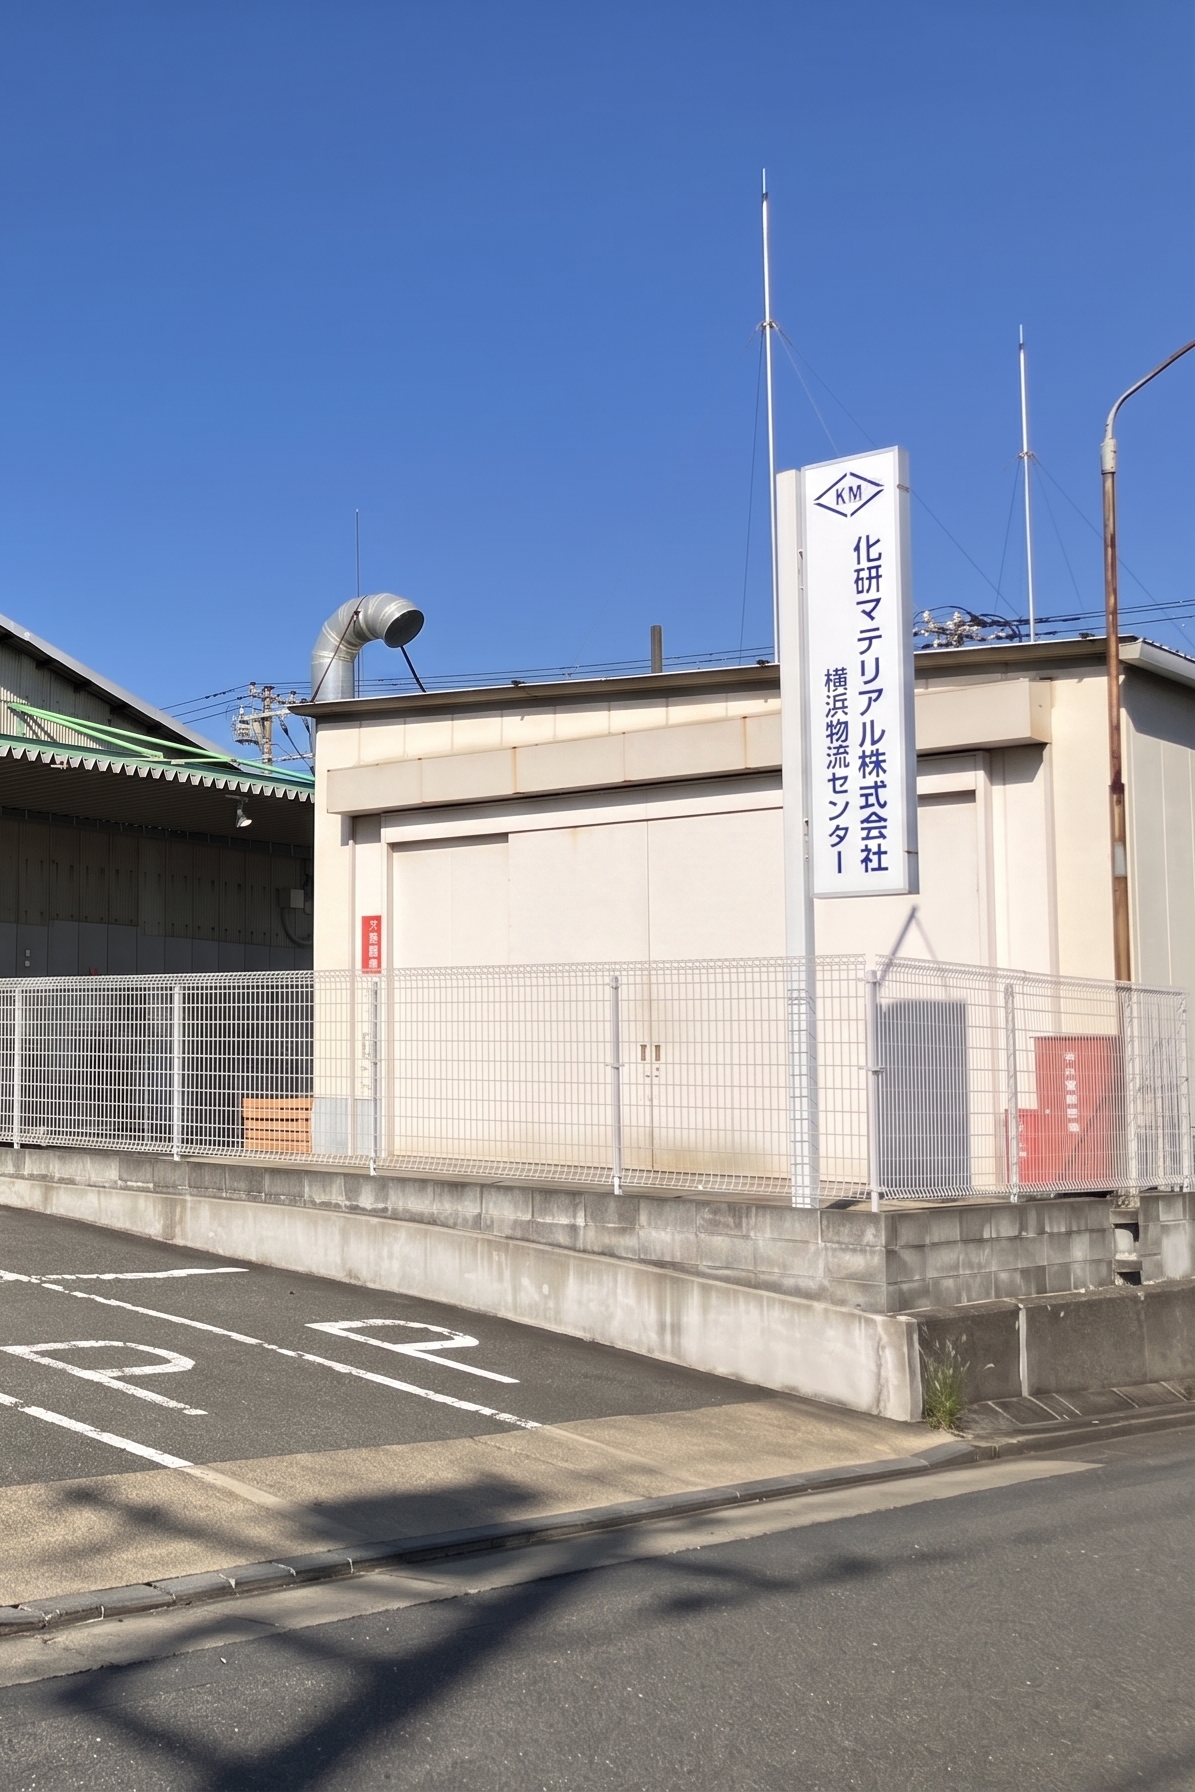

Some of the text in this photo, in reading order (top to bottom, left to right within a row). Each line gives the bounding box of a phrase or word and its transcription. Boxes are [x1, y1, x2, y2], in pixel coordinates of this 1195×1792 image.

[835, 484, 863, 506] KM
[824, 666, 851, 874] 横浜物流センター
[853, 534, 889, 874] 化研マテリアル株式会社
[305, 1319, 521, 1383] P
